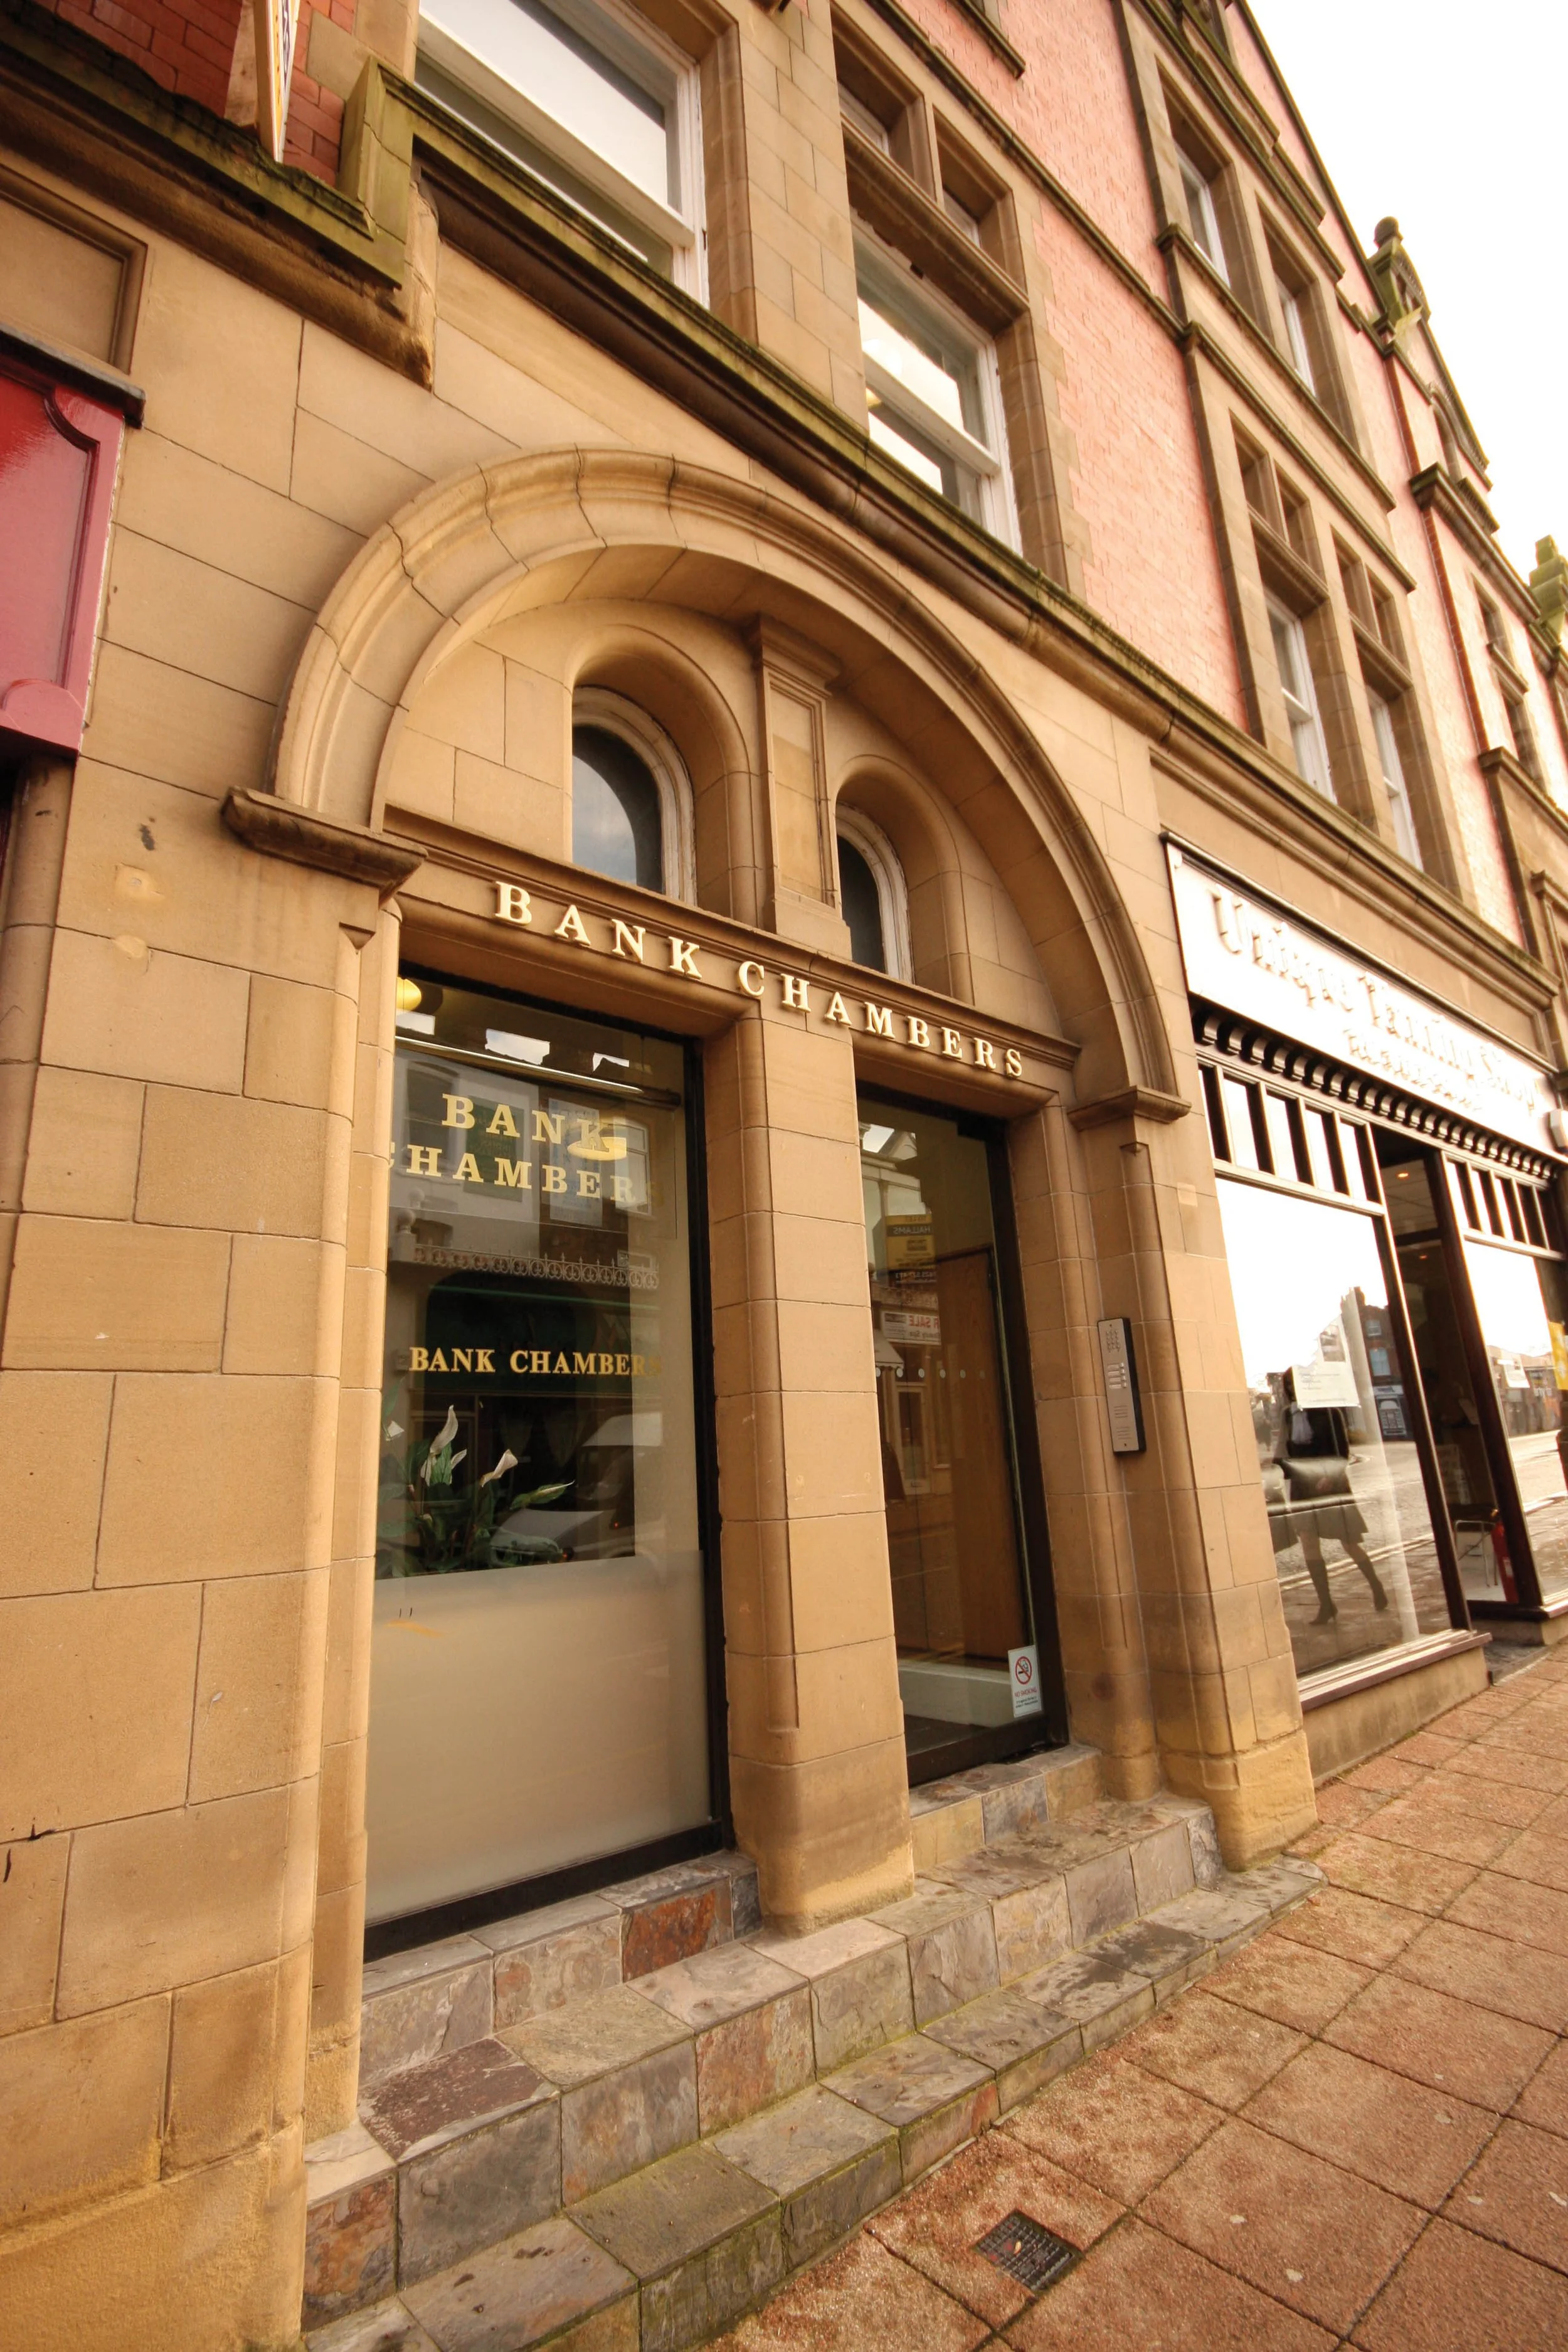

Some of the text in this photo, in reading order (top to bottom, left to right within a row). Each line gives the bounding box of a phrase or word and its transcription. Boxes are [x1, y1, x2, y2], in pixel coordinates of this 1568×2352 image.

[494, 881, 1022, 1078] BANK CHAMBERS
[442, 1093, 610, 1153] BANK
[408, 1347, 662, 1376] BANK CHAMBERS
